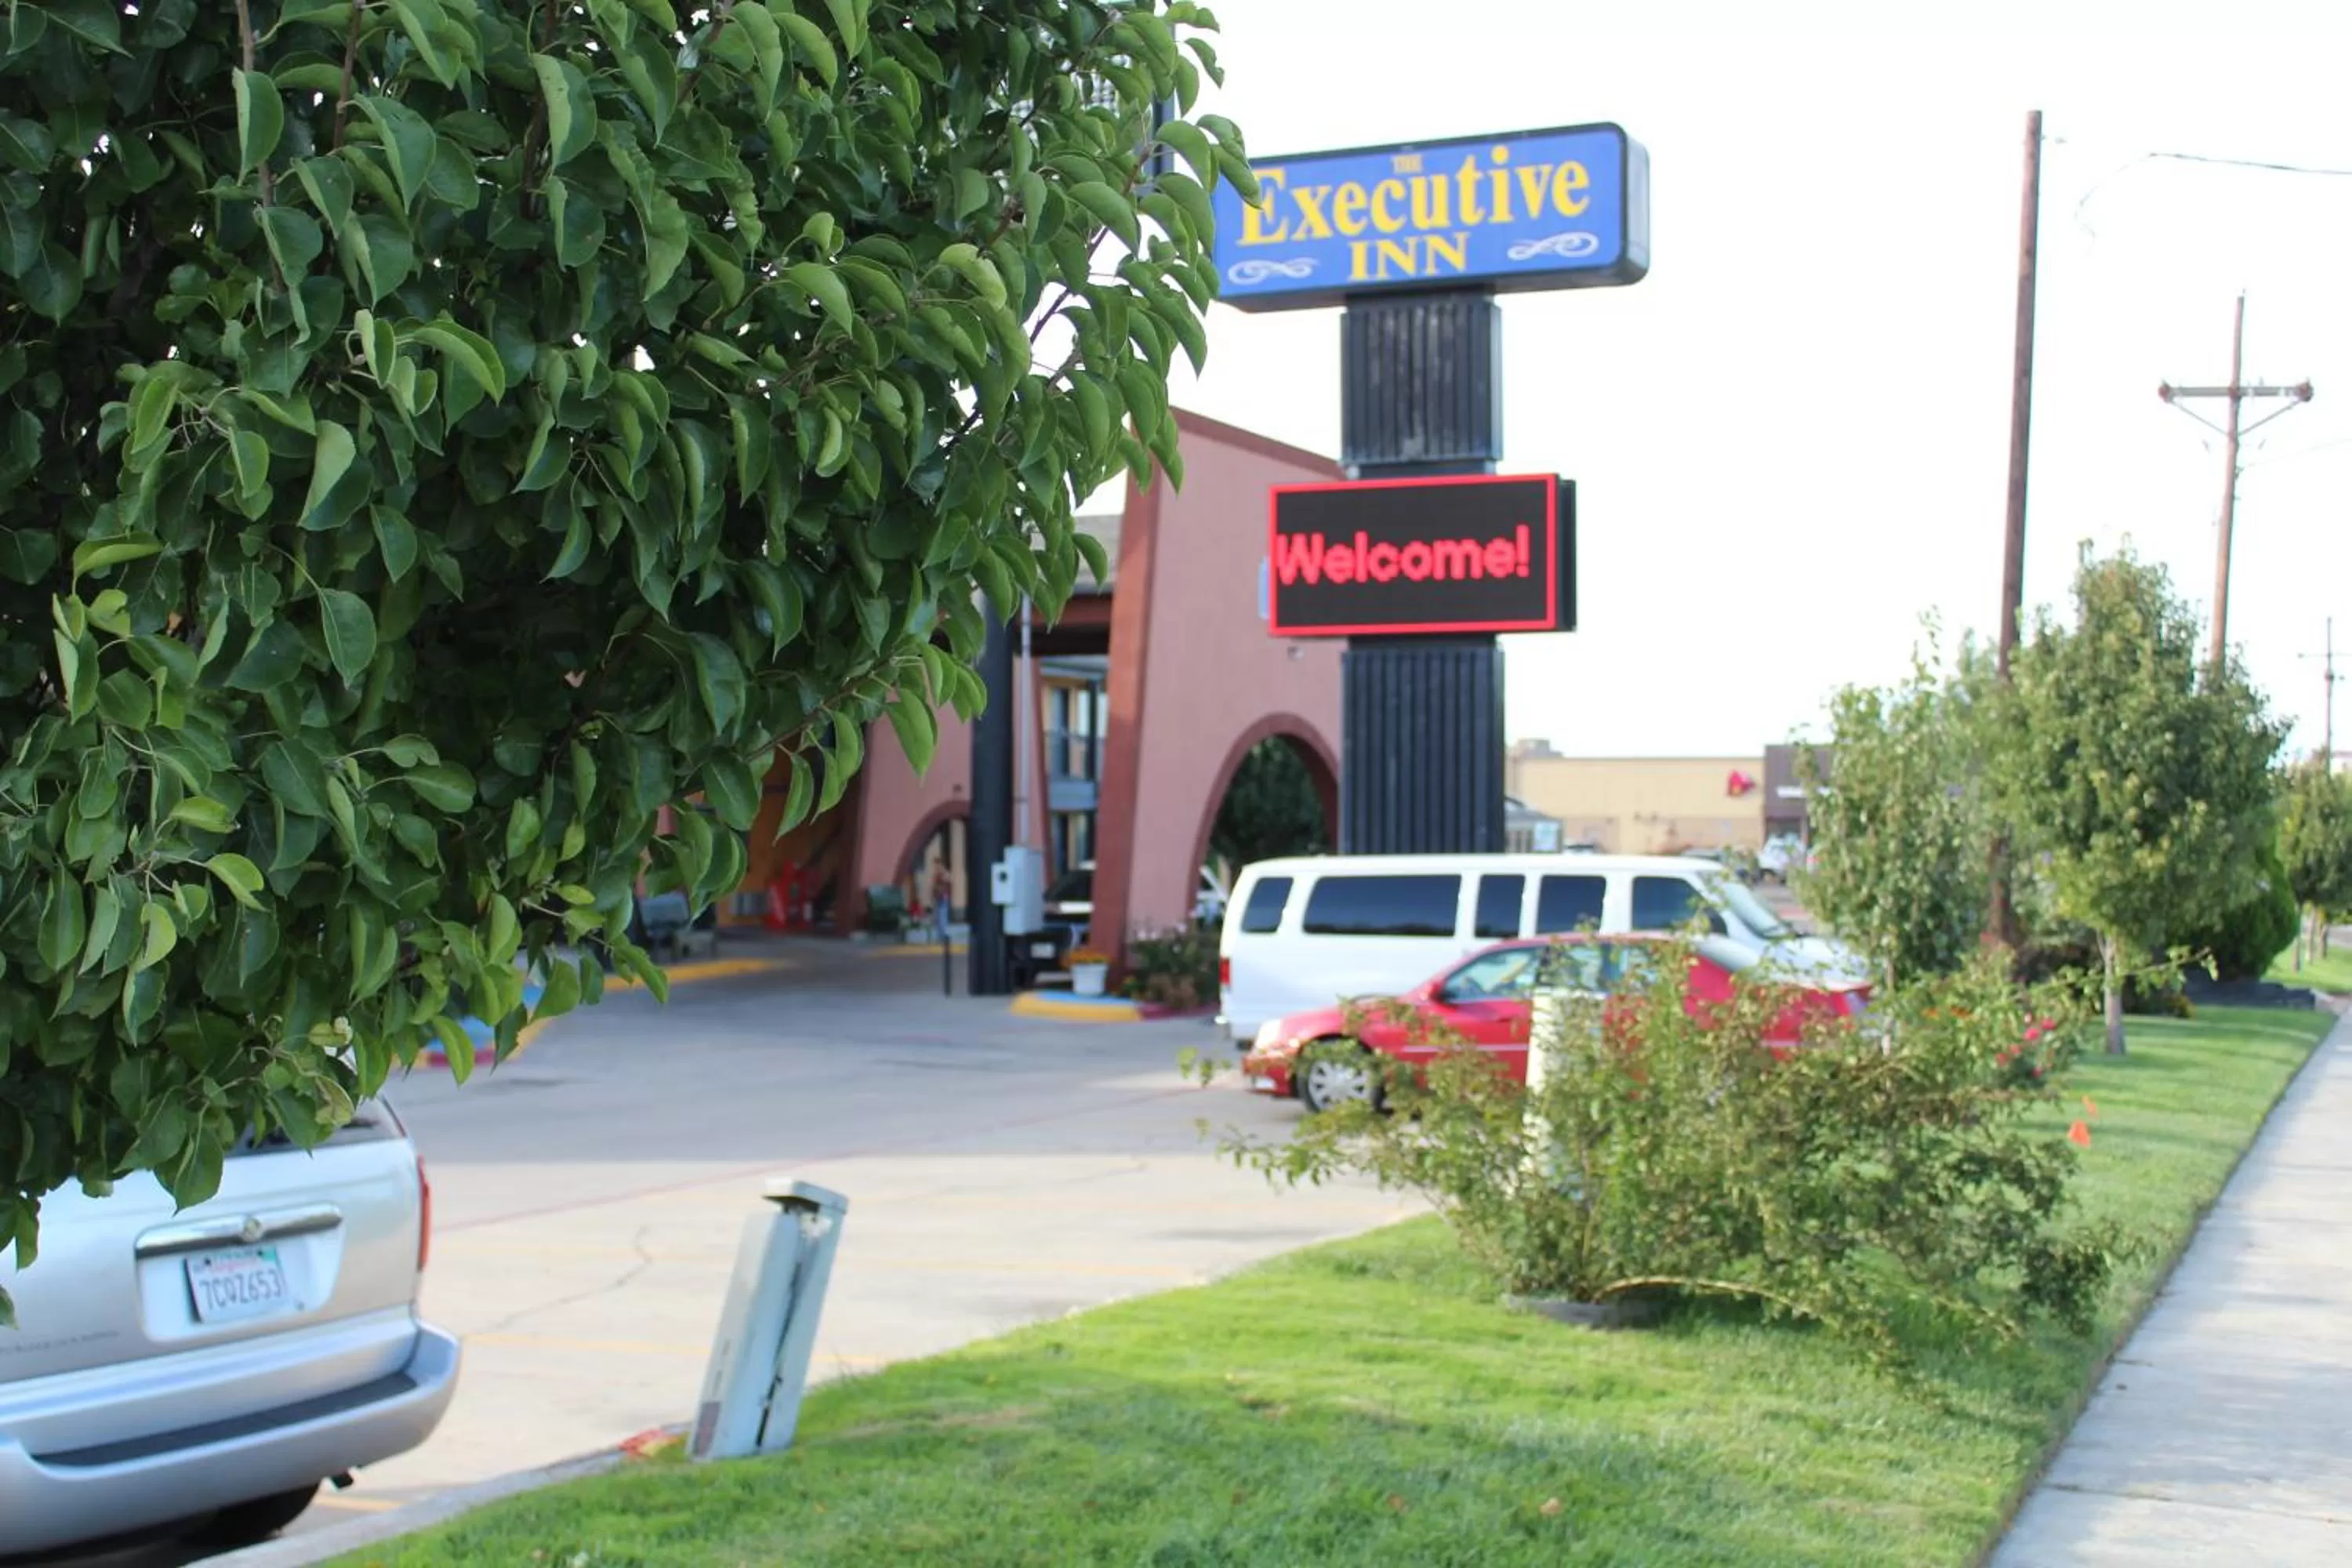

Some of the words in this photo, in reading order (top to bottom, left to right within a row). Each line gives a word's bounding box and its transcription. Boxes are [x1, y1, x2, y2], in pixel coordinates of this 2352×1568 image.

[1237, 146, 1590, 245] Executive
[1348, 233, 1469, 281] INN
[1276, 524, 1530, 585] Welcome!
